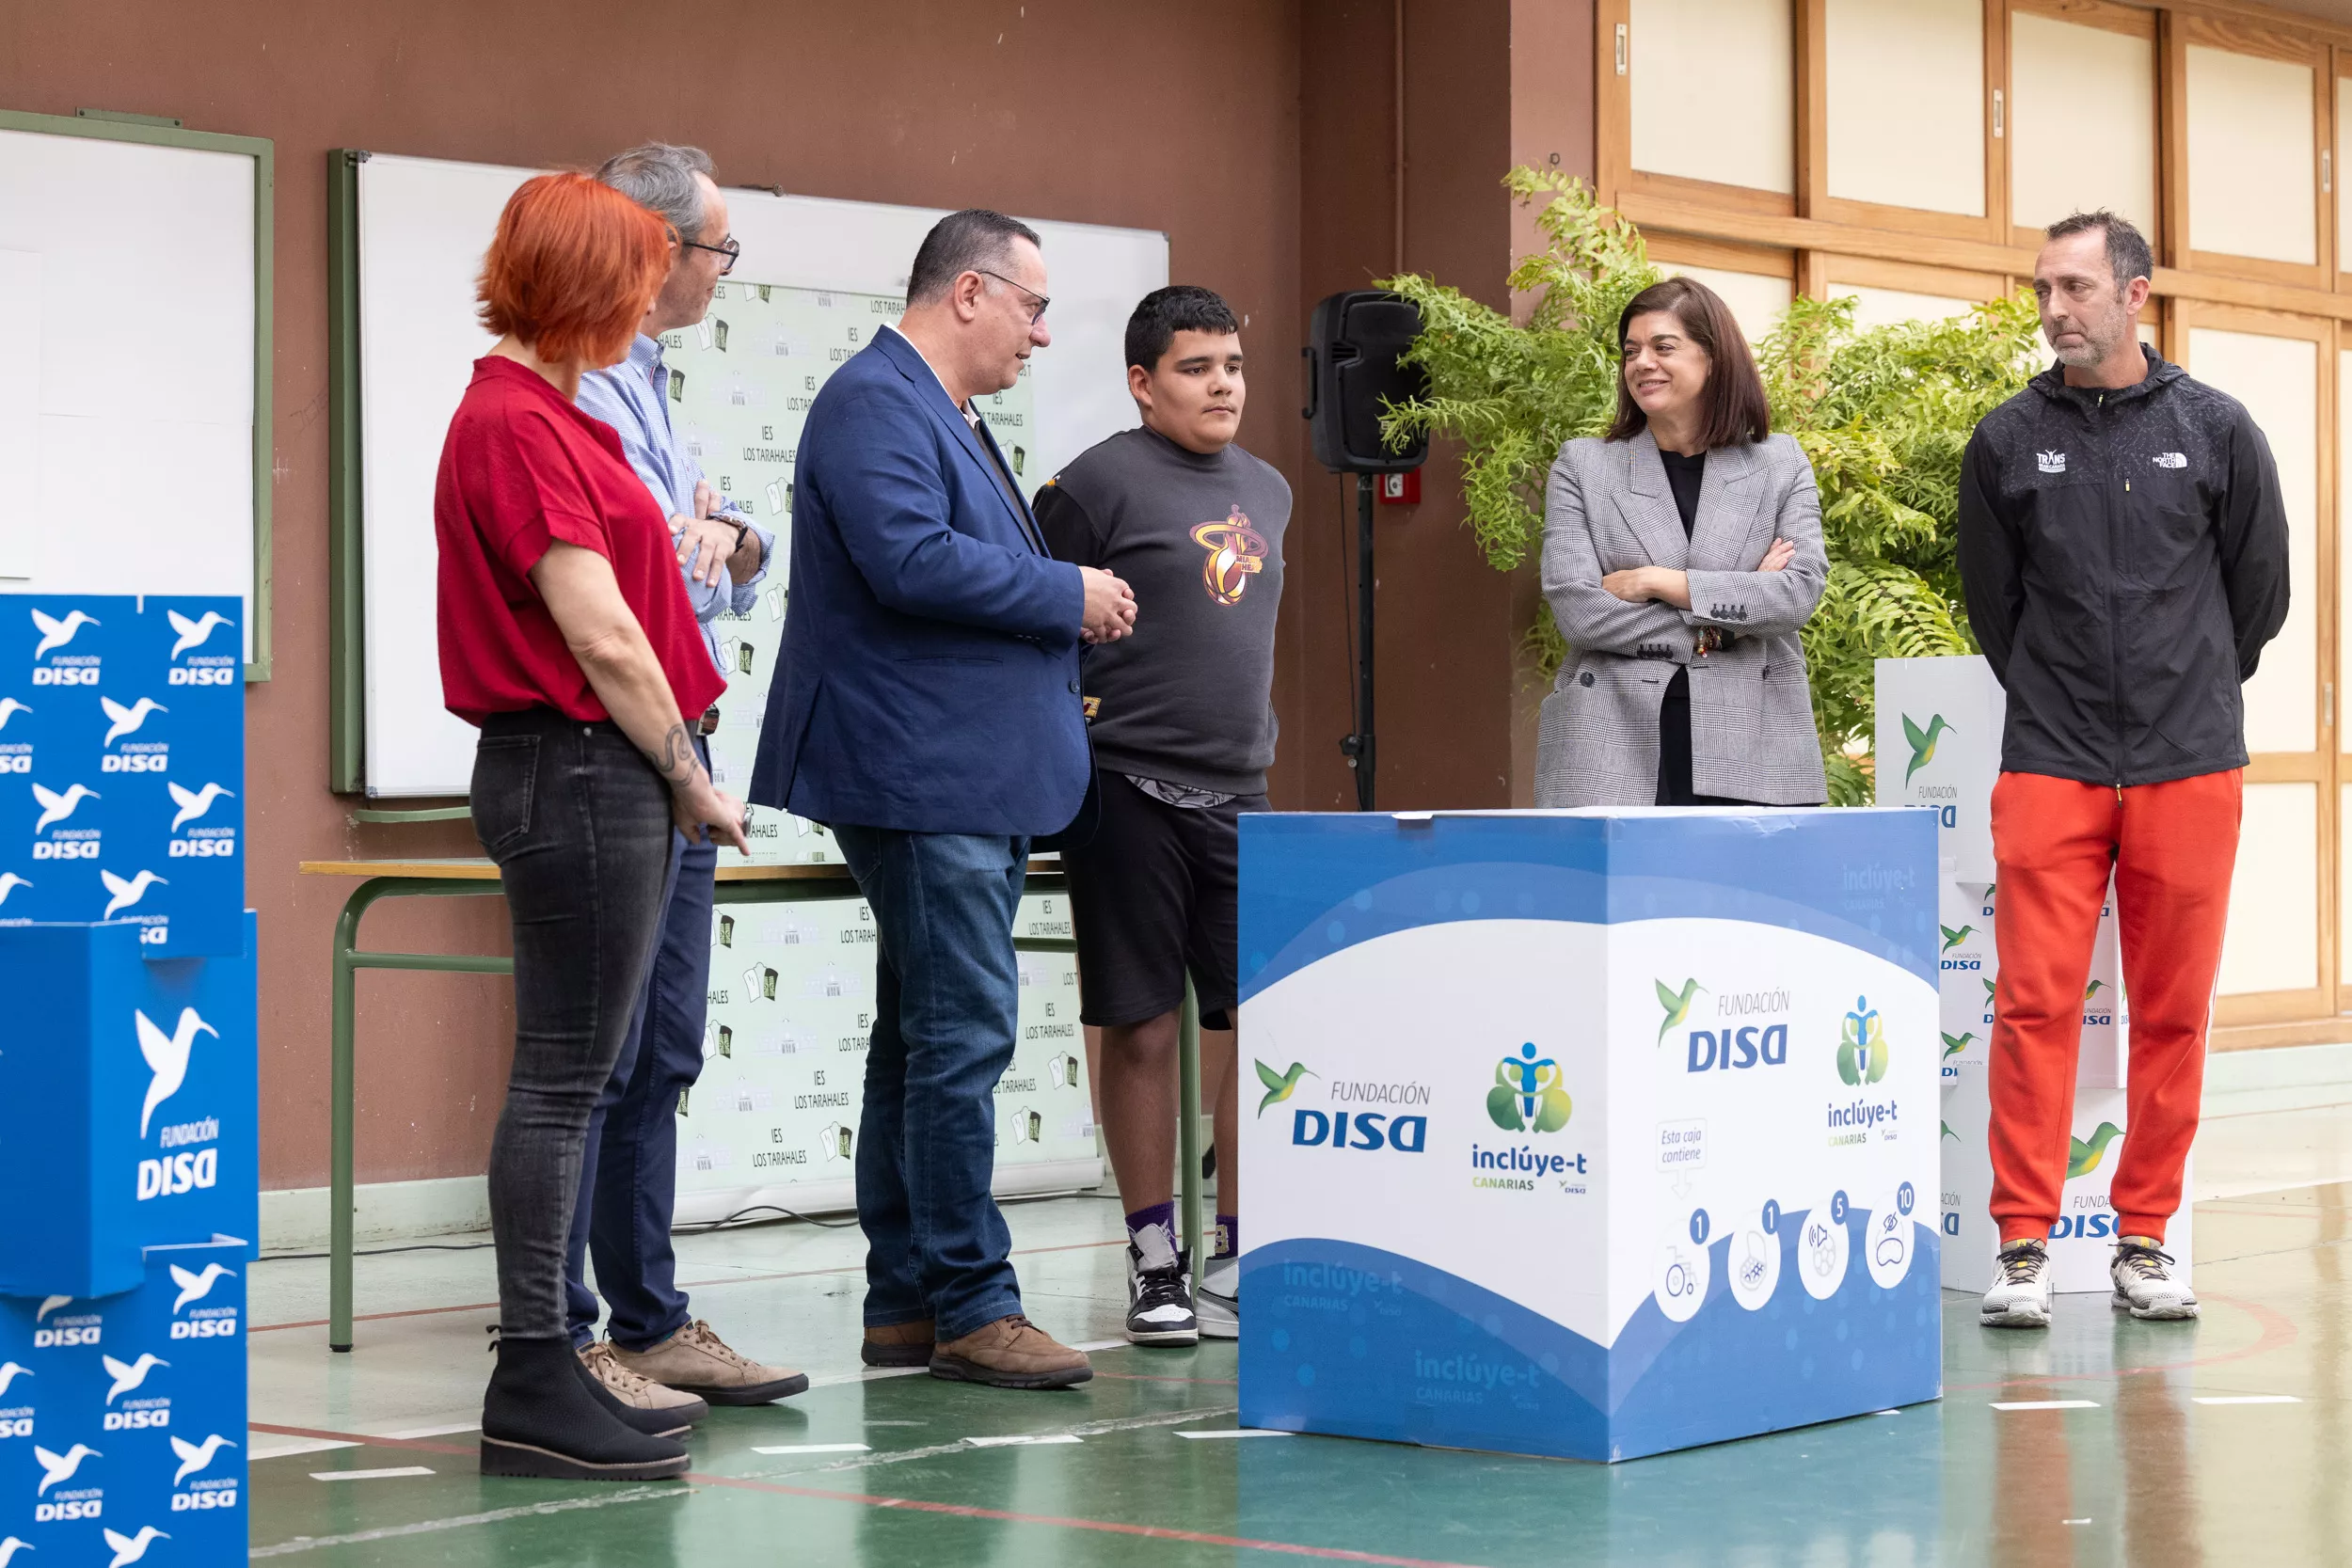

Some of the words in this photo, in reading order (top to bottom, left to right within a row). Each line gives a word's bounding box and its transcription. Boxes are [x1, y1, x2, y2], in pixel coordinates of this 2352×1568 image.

[870, 300, 882, 313] LOS
[883, 301, 905, 316] TARAH
[659, 335, 682, 348] HALES
[848, 327, 858, 341] IES
[830, 348, 842, 361] LOS
[805, 376, 815, 390] IES
[787, 397, 799, 410] LOS
[993, 391, 1003, 404] IES
[987, 411, 1023, 426] TARAHALES
[762, 425, 773, 440] IES
[743, 447, 755, 461] LOS
[756, 448, 796, 463] TARAHALES
[2036, 451, 2066, 465] TRANS
[720, 476, 731, 491] IES
[0, 754, 32, 773] SA
[1918, 784, 1957, 799] FUNDACIÓN
[859, 906, 869, 921] IES
[1042, 900, 1052, 914] IES
[841, 930, 853, 943] LOS
[854, 929, 877, 942] TARAH
[1941, 960, 1980, 970] DISA
[707, 990, 728, 1004] HALES
[1718, 987, 1789, 1016] FUNDACIÓN
[1045, 1003, 1055, 1017] IES
[858, 1014, 868, 1028] IES
[2083, 1016, 2110, 1024] ISA
[1025, 1025, 1038, 1039] LOS
[1040, 1024, 1074, 1038] TARAHALES
[838, 1037, 850, 1052] LOS
[1687, 1023, 1788, 1073] DISA
[814, 1070, 825, 1085] IES
[1002, 1079, 1036, 1093] TARAHALES
[1331, 1081, 1430, 1105] FUNDACIÓN
[794, 1095, 807, 1109] LOS
[808, 1092, 849, 1108] TARAHALES
[1828, 1099, 1897, 1129] inclúye-t
[160, 1117, 219, 1148] FUNDACIÓN
[771, 1129, 783, 1143] IES
[1293, 1110, 1427, 1153] DISA
[1661, 1130, 1681, 1145] Esta
[1683, 1128, 1702, 1145] caja
[1828, 1132, 1867, 1147] CANARIAS
[753, 1153, 768, 1167] LOS
[768, 1150, 807, 1165] TARAHALES
[1472, 1144, 1587, 1177] inclúye-t
[1661, 1147, 1701, 1164] contiene
[136, 1148, 217, 1201] DISA
[1472, 1177, 1534, 1191] CANARIAS
[1900, 1188, 1912, 1209] 10
[1941, 1191, 1961, 1207] ACIÓN
[2074, 1196, 2110, 1209] FUNDA
[1836, 1197, 1844, 1218] 5
[1769, 1207, 1773, 1228] 1
[1697, 1215, 1703, 1239] 1
[0, 1418, 34, 1438] SA
